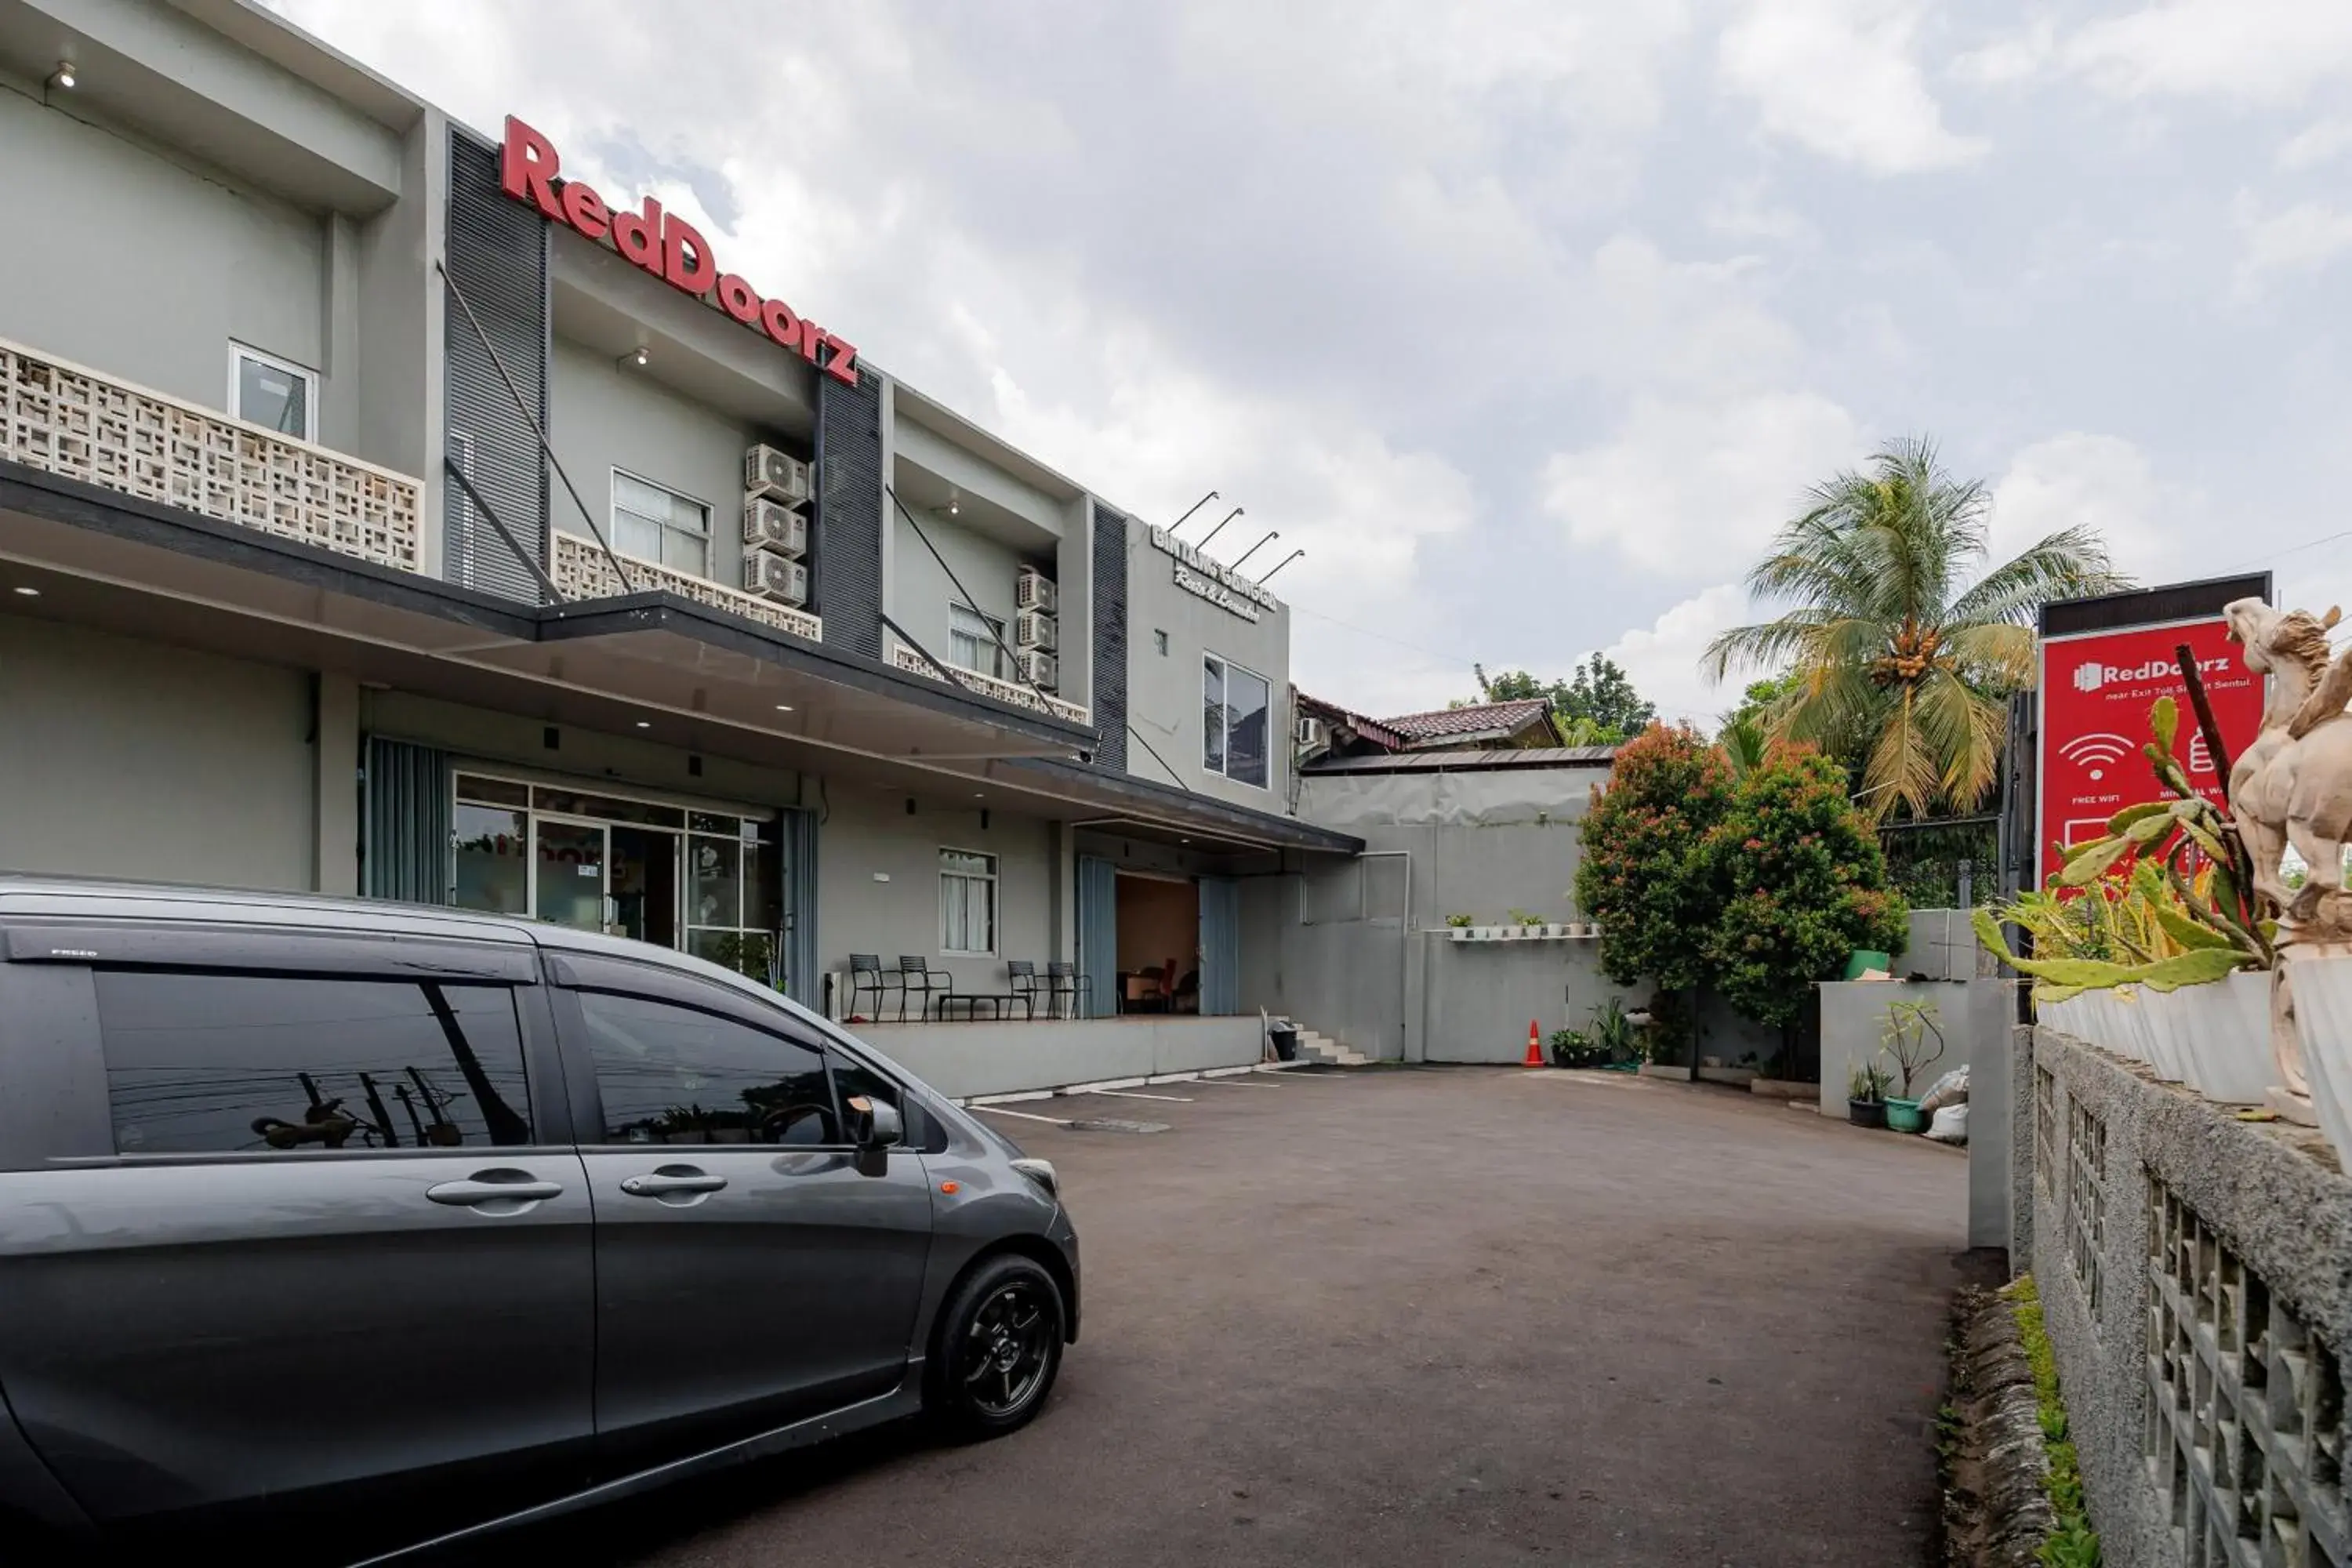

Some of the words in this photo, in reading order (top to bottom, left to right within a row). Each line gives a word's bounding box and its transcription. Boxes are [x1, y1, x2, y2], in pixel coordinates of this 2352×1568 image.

[501, 114, 858, 387] RedDoorz
[1207, 584, 1217, 601] &
[2132, 688, 2151, 699] Exit
[2072, 796, 2097, 805] FREE
